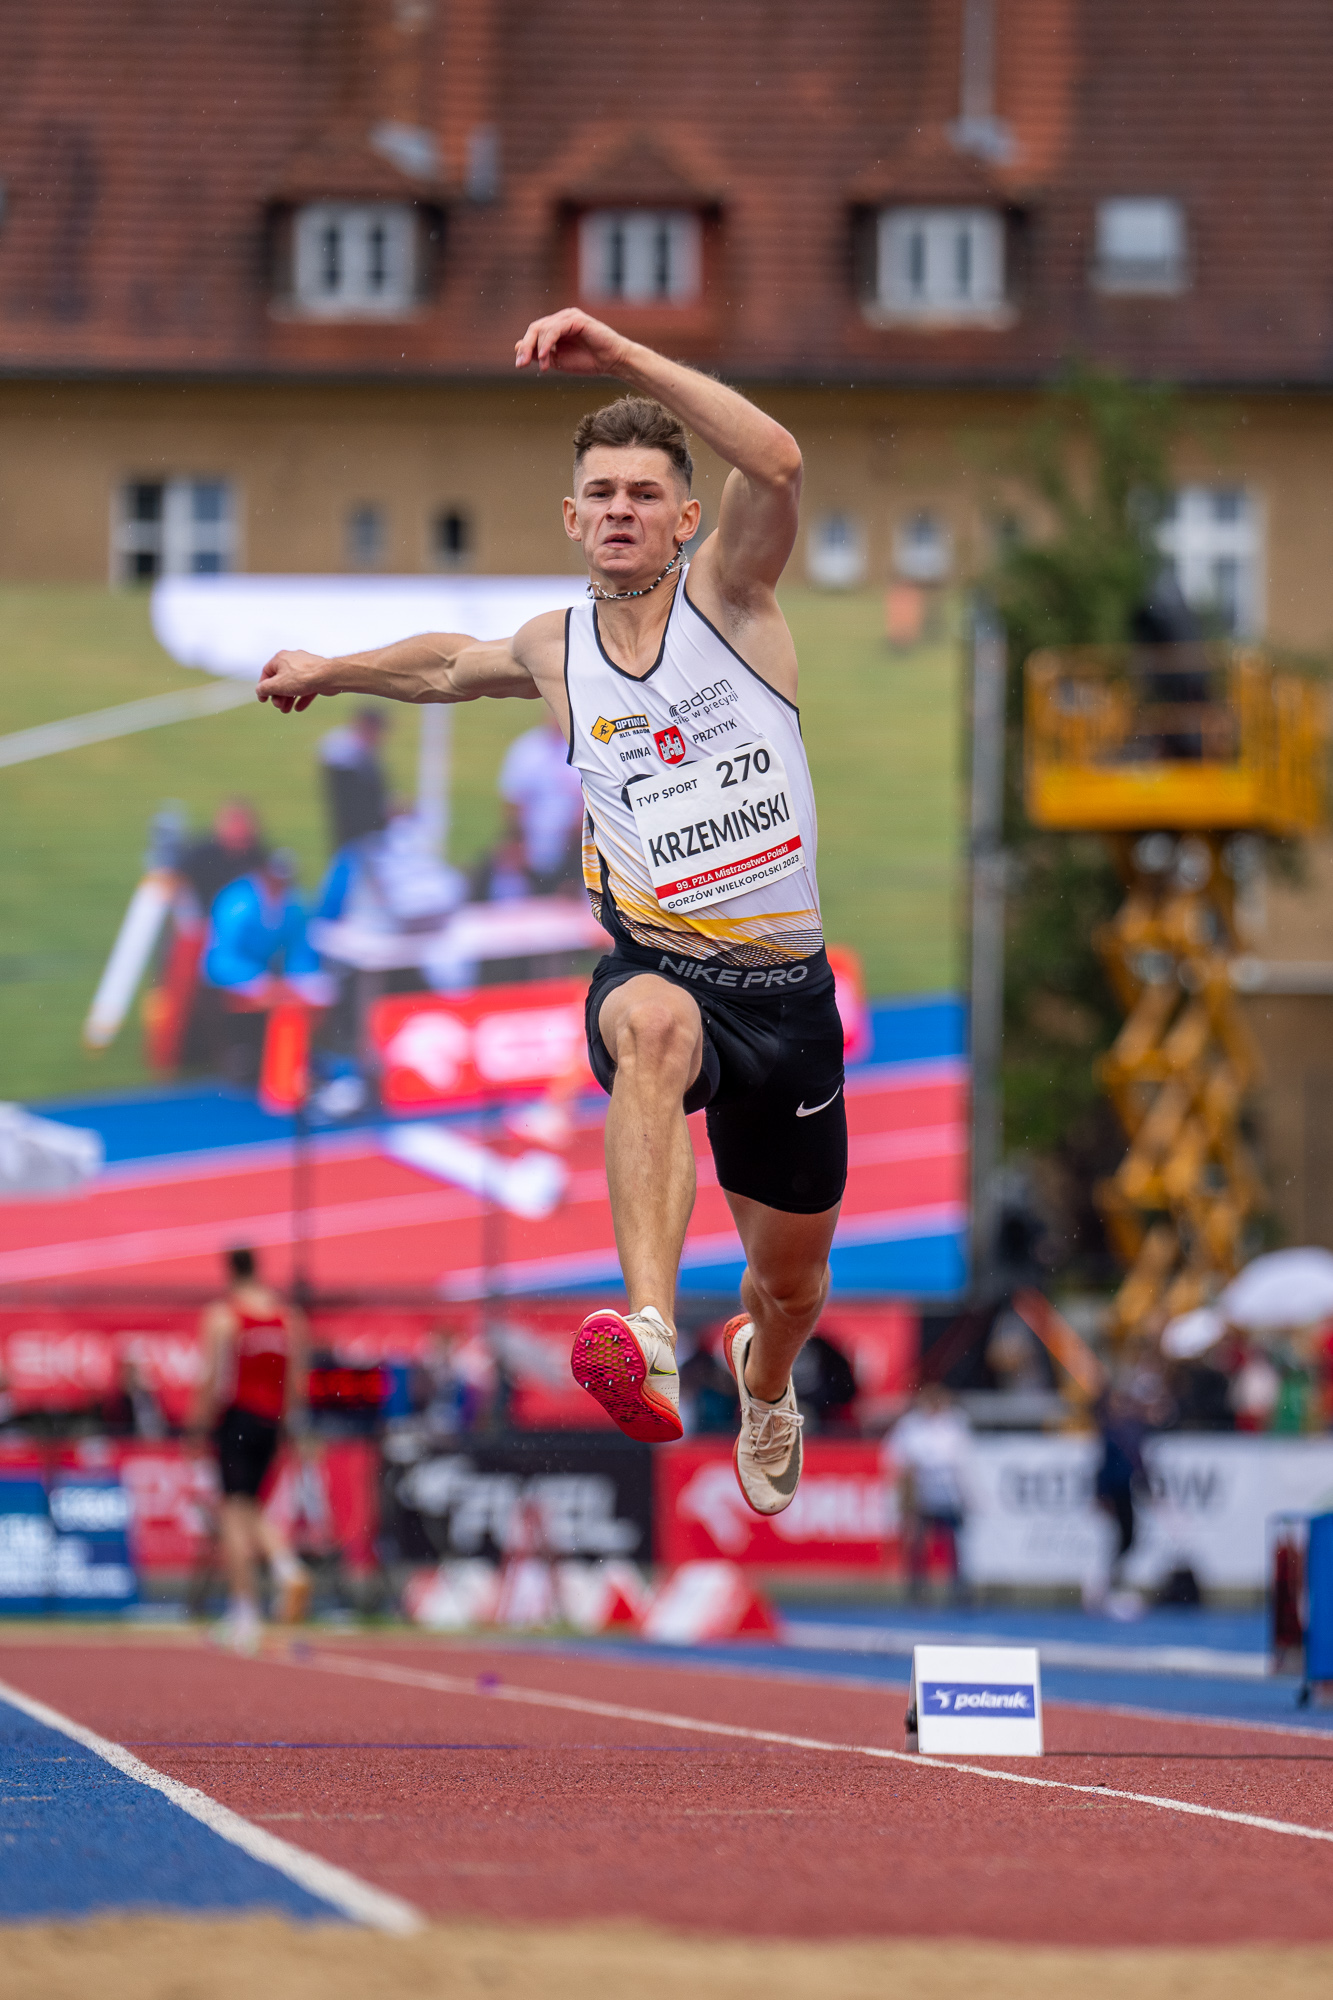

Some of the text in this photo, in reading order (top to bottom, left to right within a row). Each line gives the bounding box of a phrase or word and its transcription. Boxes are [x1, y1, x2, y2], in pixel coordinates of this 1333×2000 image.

[692, 710, 701, 718] w
[703, 691, 738, 714] precyzji
[692, 718, 737, 743] PRZYTYK
[620, 747, 651, 762] GMINA
[715, 748, 770, 788] 270
[636, 779, 698, 807] TVP SPORT
[648, 792, 790, 867] KRZEMIŃSKI
[667, 854, 800, 909] GORZÓW WIELKOPOLSKI 2023
[676, 844, 788, 891] 99. PZLA Mistrzostwa Polski
[658, 955, 808, 988] NIKE PRO
[954, 1690, 1027, 1711] polanik
